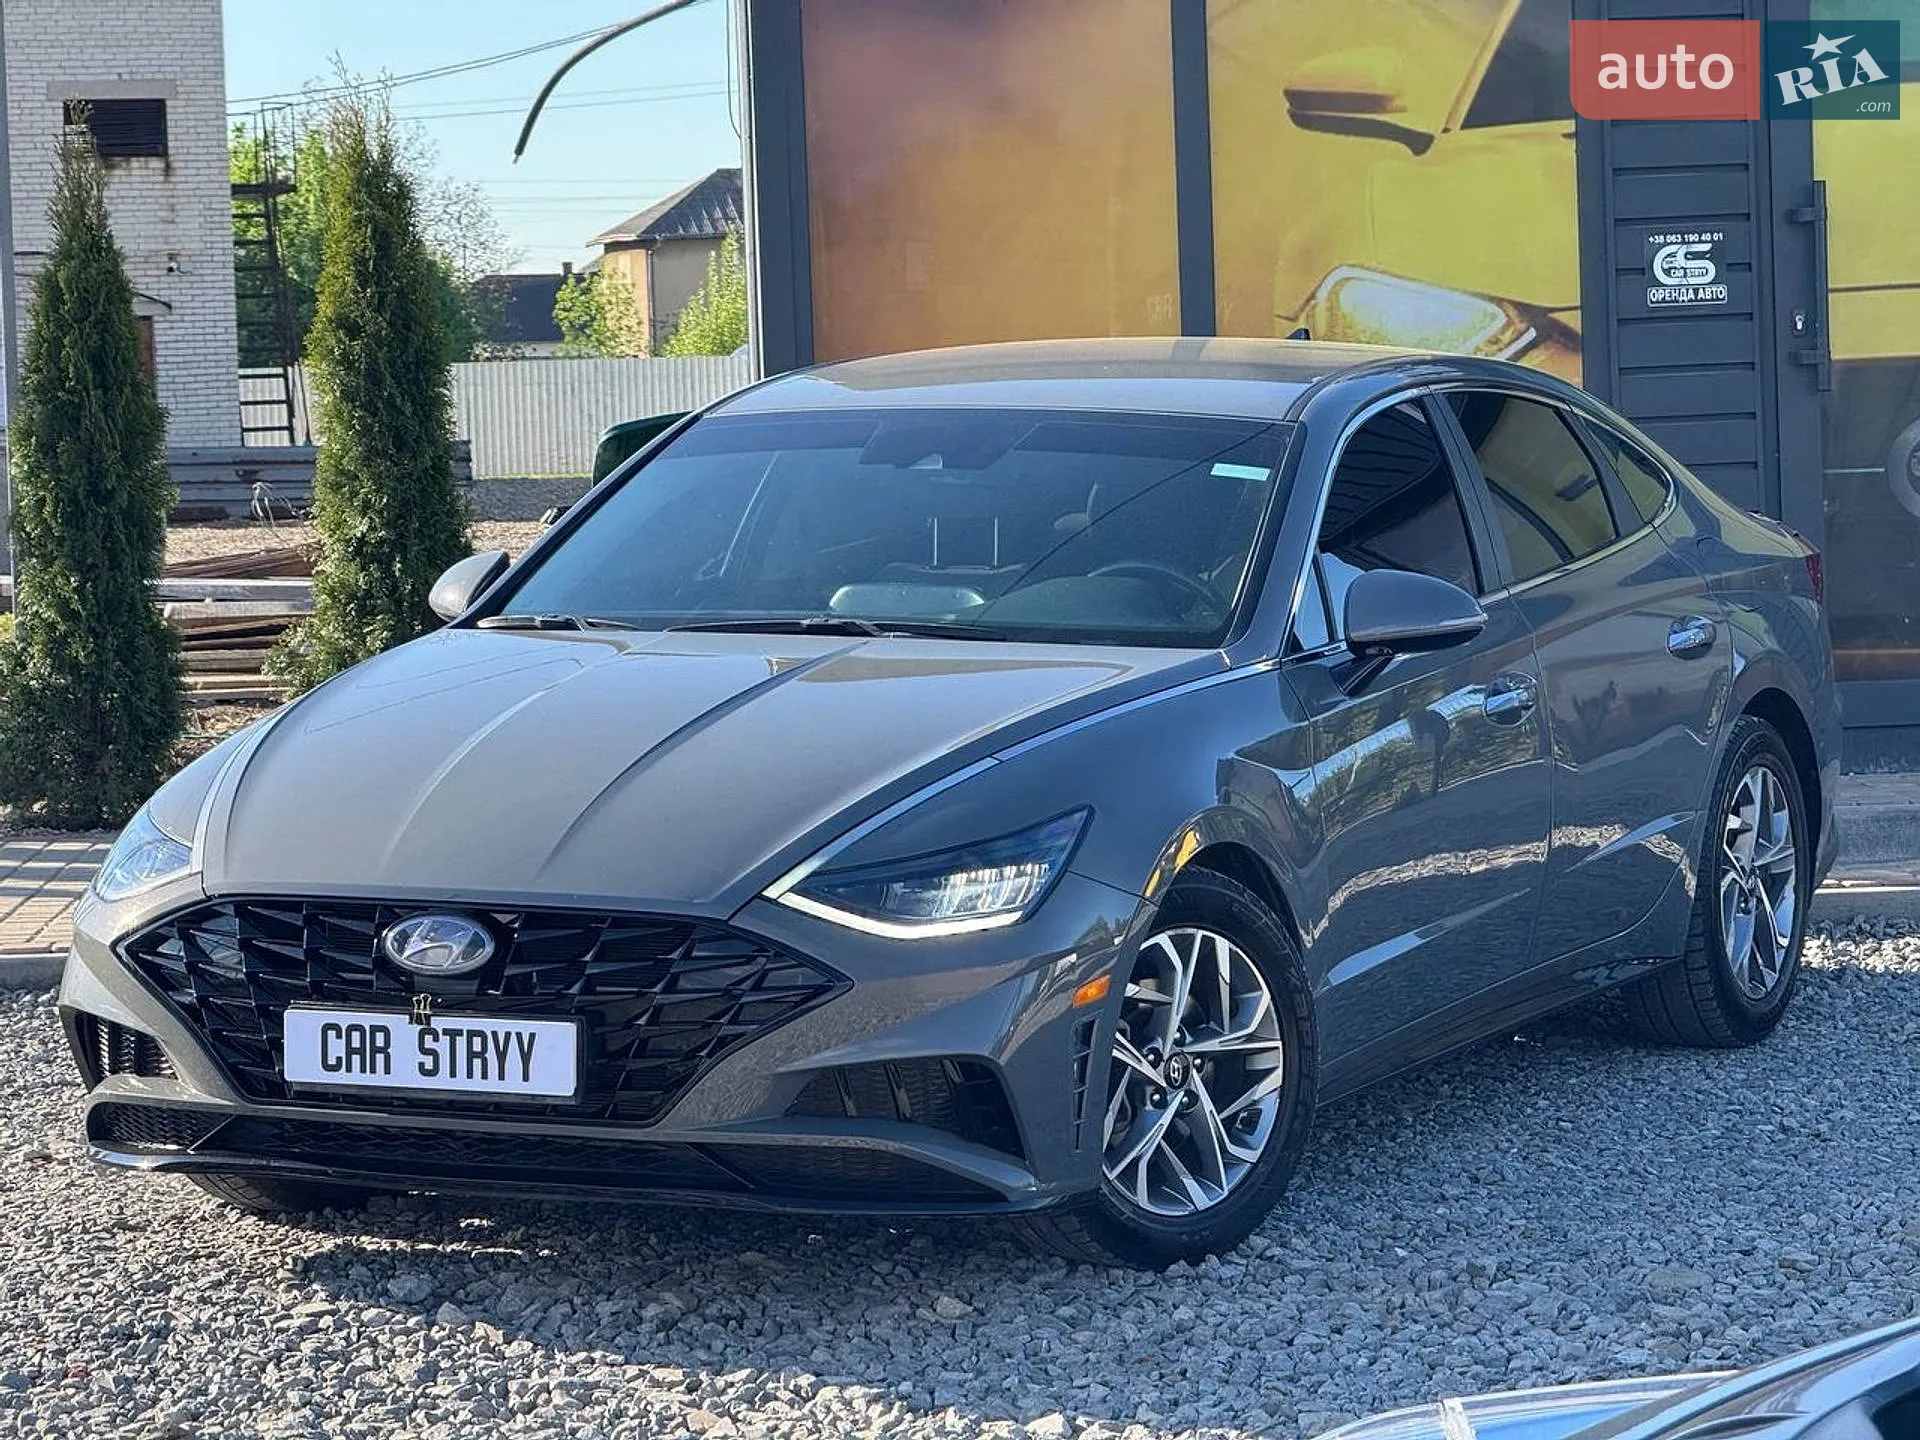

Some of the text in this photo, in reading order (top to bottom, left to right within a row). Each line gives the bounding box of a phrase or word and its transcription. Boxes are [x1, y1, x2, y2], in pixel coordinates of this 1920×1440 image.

[1650, 286, 1725, 301] ОРЕНДА АВТО
[320, 1022, 537, 1083] CAR STRYY
